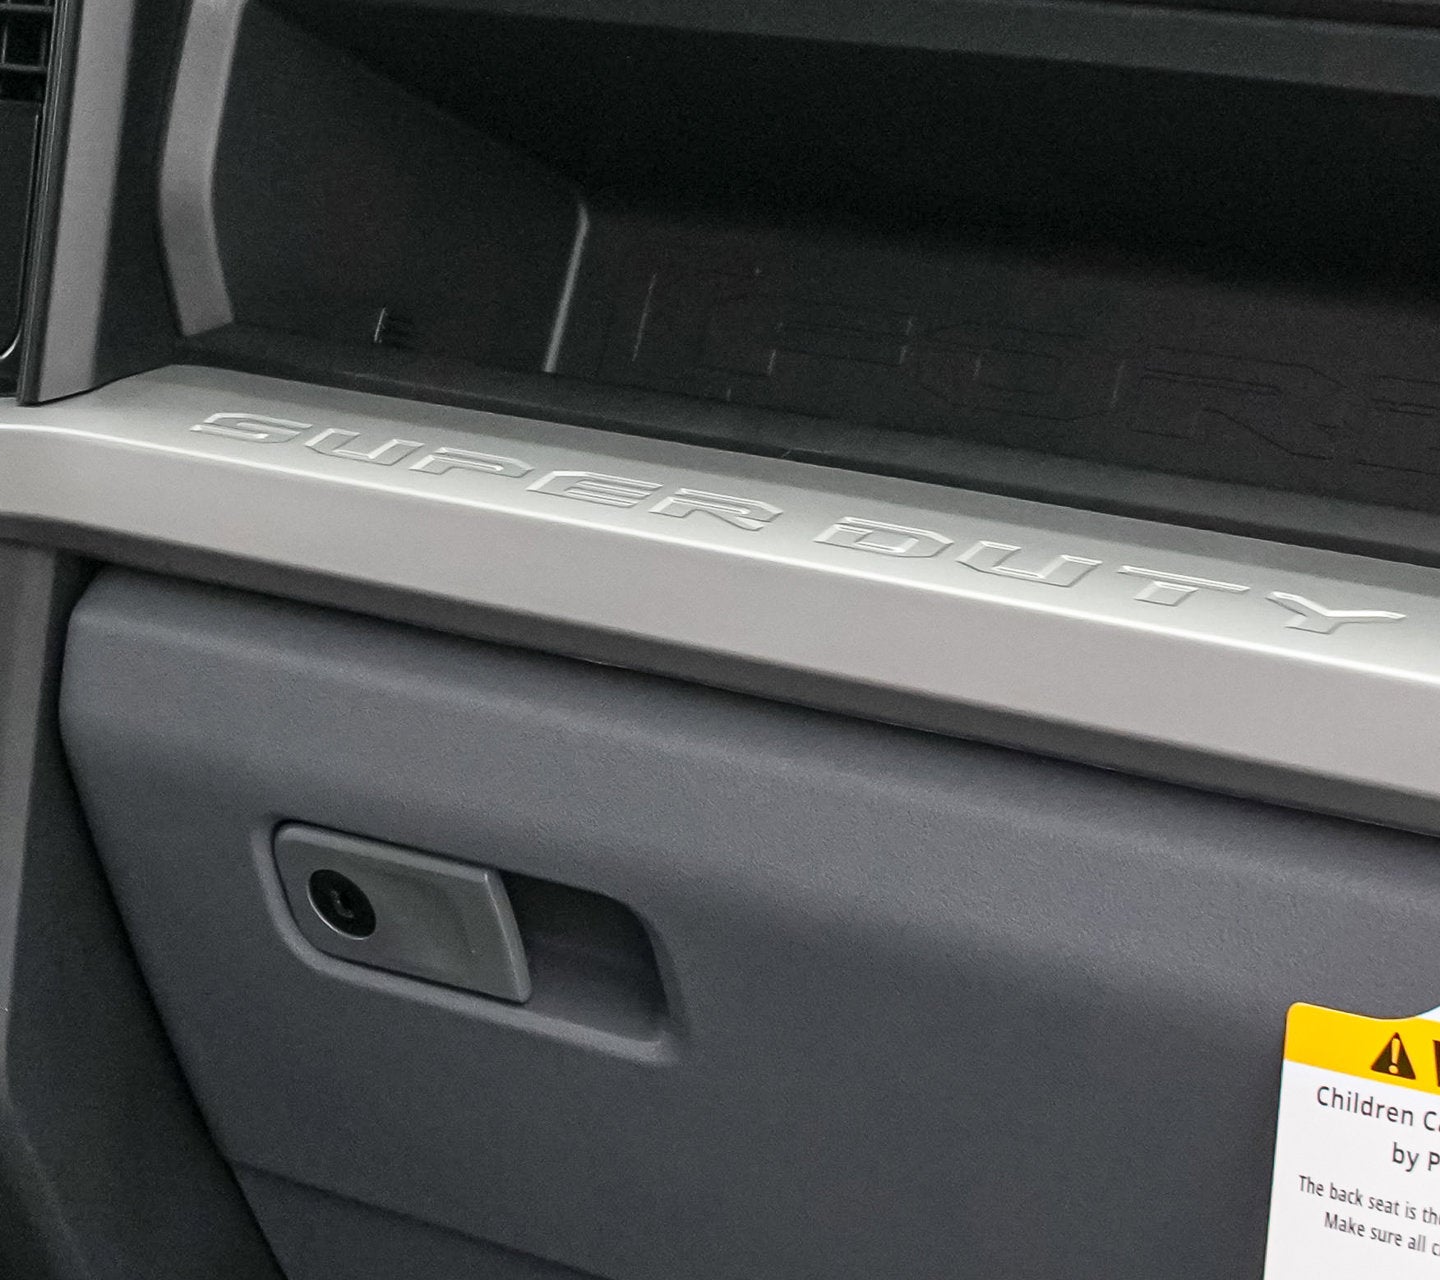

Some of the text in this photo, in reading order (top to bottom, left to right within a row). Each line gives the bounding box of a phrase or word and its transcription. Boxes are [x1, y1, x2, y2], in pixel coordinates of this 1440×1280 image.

[189, 411, 1408, 636] SUPER DUTY
[1316, 1085, 1415, 1127] Children
[1391, 1141, 1420, 1173] by
[1298, 1174, 1325, 1197] The
[1329, 1181, 1364, 1208] back
[1368, 1195, 1400, 1216] seat
[1405, 1201, 1417, 1220] is
[1323, 1210, 1366, 1238] Make
[1369, 1226, 1403, 1248] sure
[1407, 1232, 1427, 1254] all
